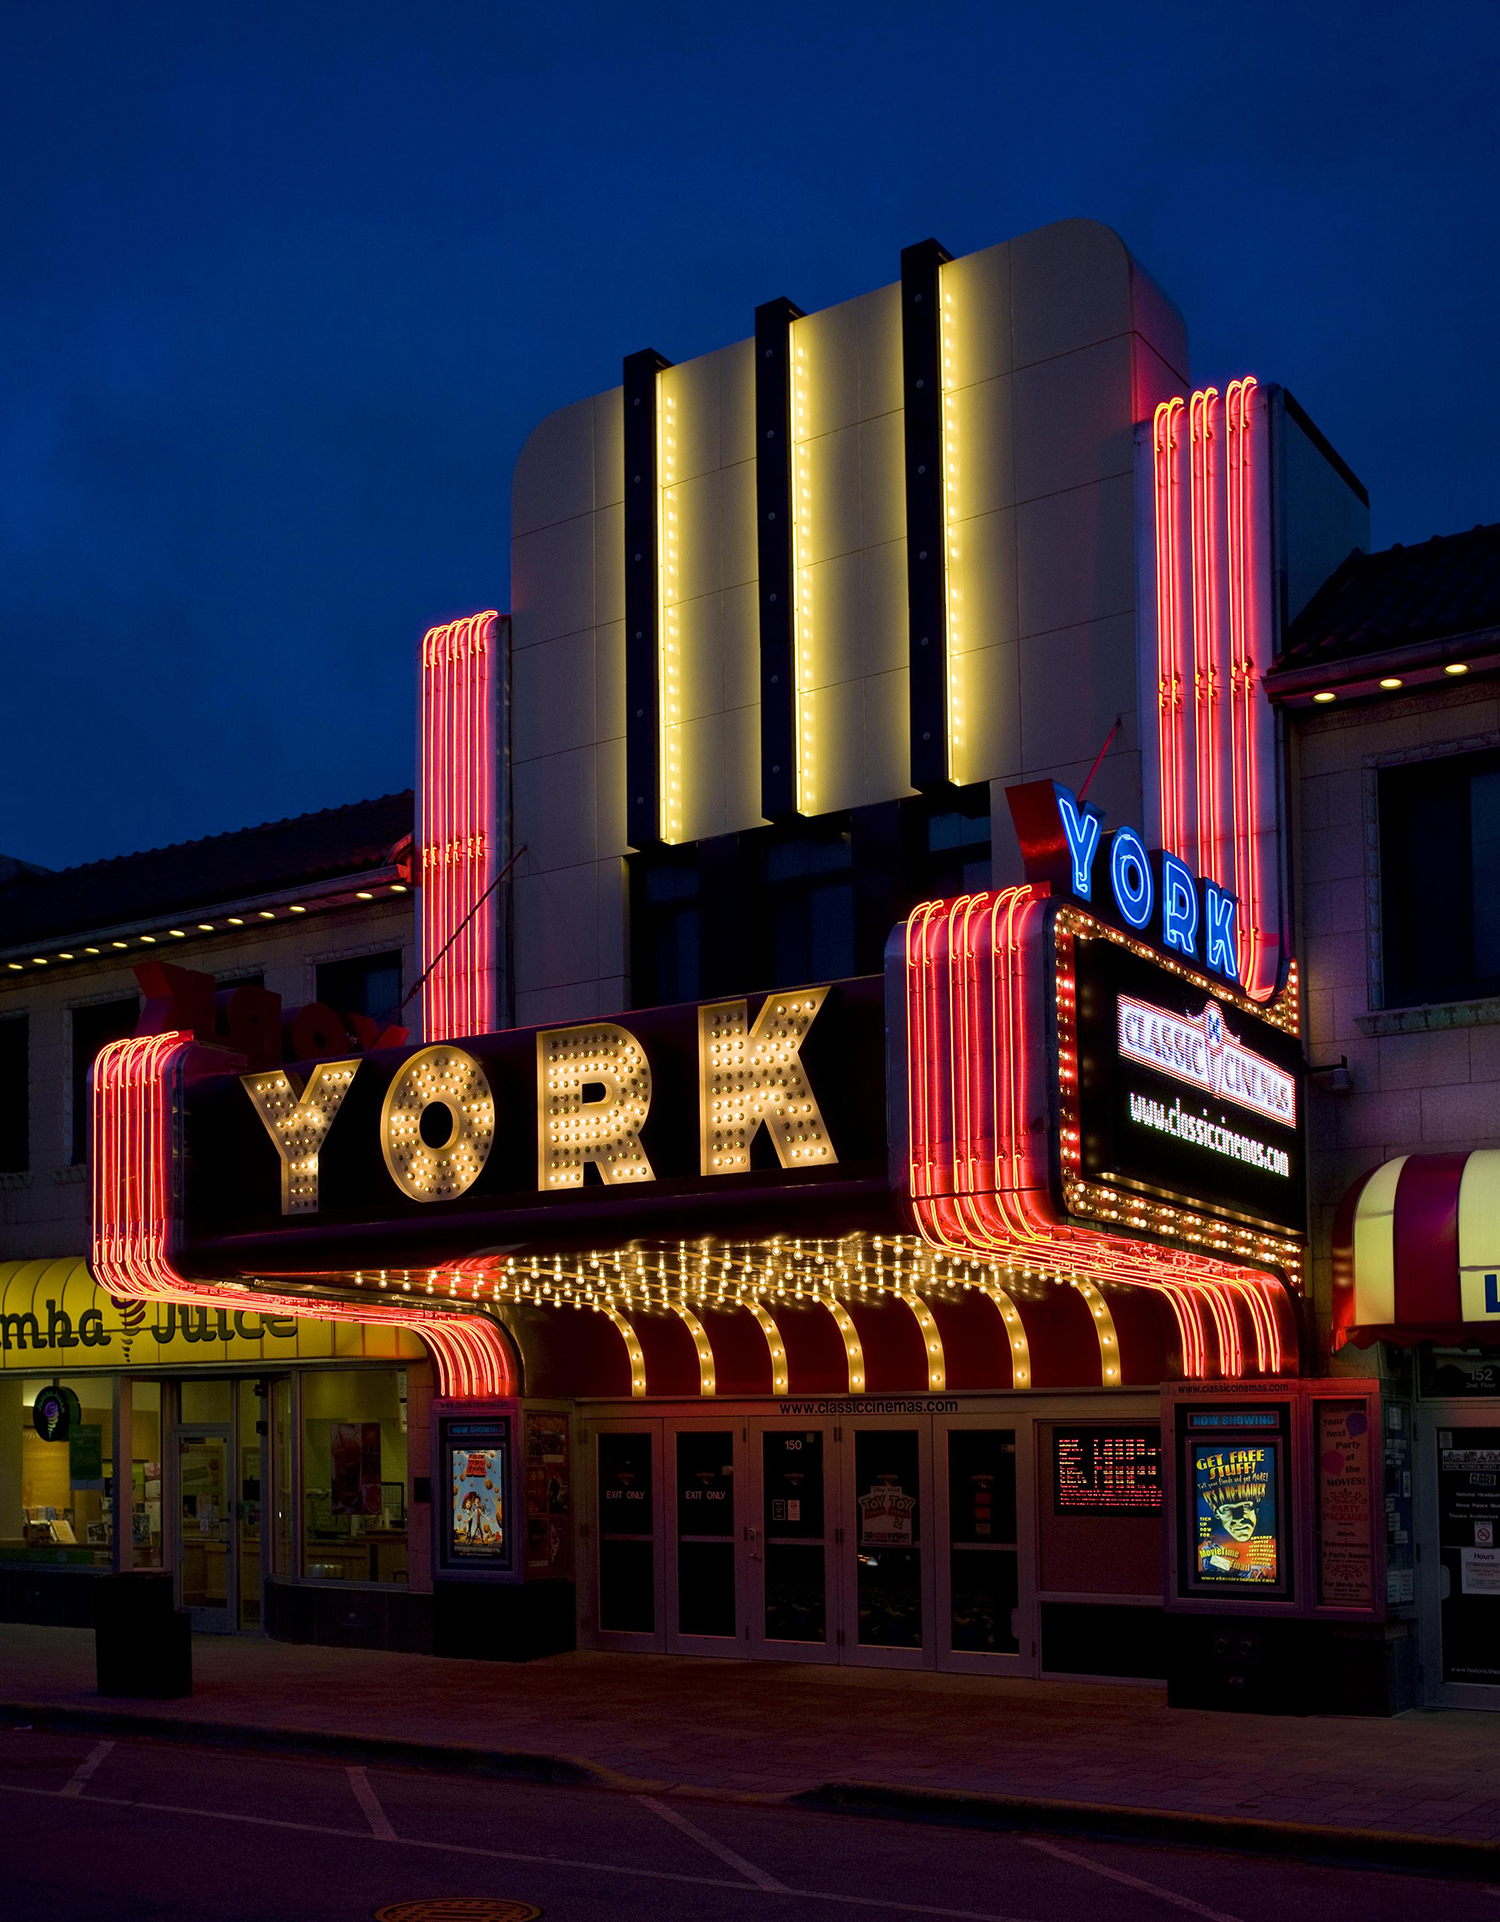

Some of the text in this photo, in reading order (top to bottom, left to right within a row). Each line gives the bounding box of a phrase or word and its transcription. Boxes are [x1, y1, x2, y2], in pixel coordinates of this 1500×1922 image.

[1053, 782, 1240, 984] YORK
[1123, 1012, 1290, 1113] CLASSIC CINEMAS
[239, 985, 840, 1216] YORK
[1130, 1092, 1289, 1177] www.classiccinemas.com
[0, 1299, 111, 1349] mba
[1470, 1368, 1493, 1382] 152
[1178, 1382, 1289, 1394] www.classiccinemas.com
[779, 1400, 958, 1414] www.classiccinemas.com
[1193, 1415, 1275, 1426] NOW SHOWING
[1323, 1418, 1344, 1426] your
[452, 1425, 503, 1434] NOW SHOWING
[784, 1439, 803, 1451] 150
[1336, 1441, 1361, 1449] Party
[1196, 1449, 1265, 1470] GET FREE
[1345, 1453, 1354, 1461] at
[1209, 1462, 1257, 1480] STUFF!
[1345, 1465, 1360, 1473] the
[1326, 1477, 1366, 1487] MOVIES!
[1471, 1474, 1495, 1484] CLOSED
[606, 1490, 645, 1500] EXIT ONLY
[685, 1490, 726, 1500] EXIT ONLY
[1218, 1487, 1225, 1504] A
[862, 1495, 915, 1511] TOY TOY
[1332, 1505, 1360, 1513] PARTY
[893, 1516, 904, 1529] 2
[1323, 1513, 1368, 1521] PACKAGES
[1199, 1547, 1240, 1559] MovieTime
[1473, 1552, 1495, 1560] Hours
[1230, 1559, 1250, 1572] Email
